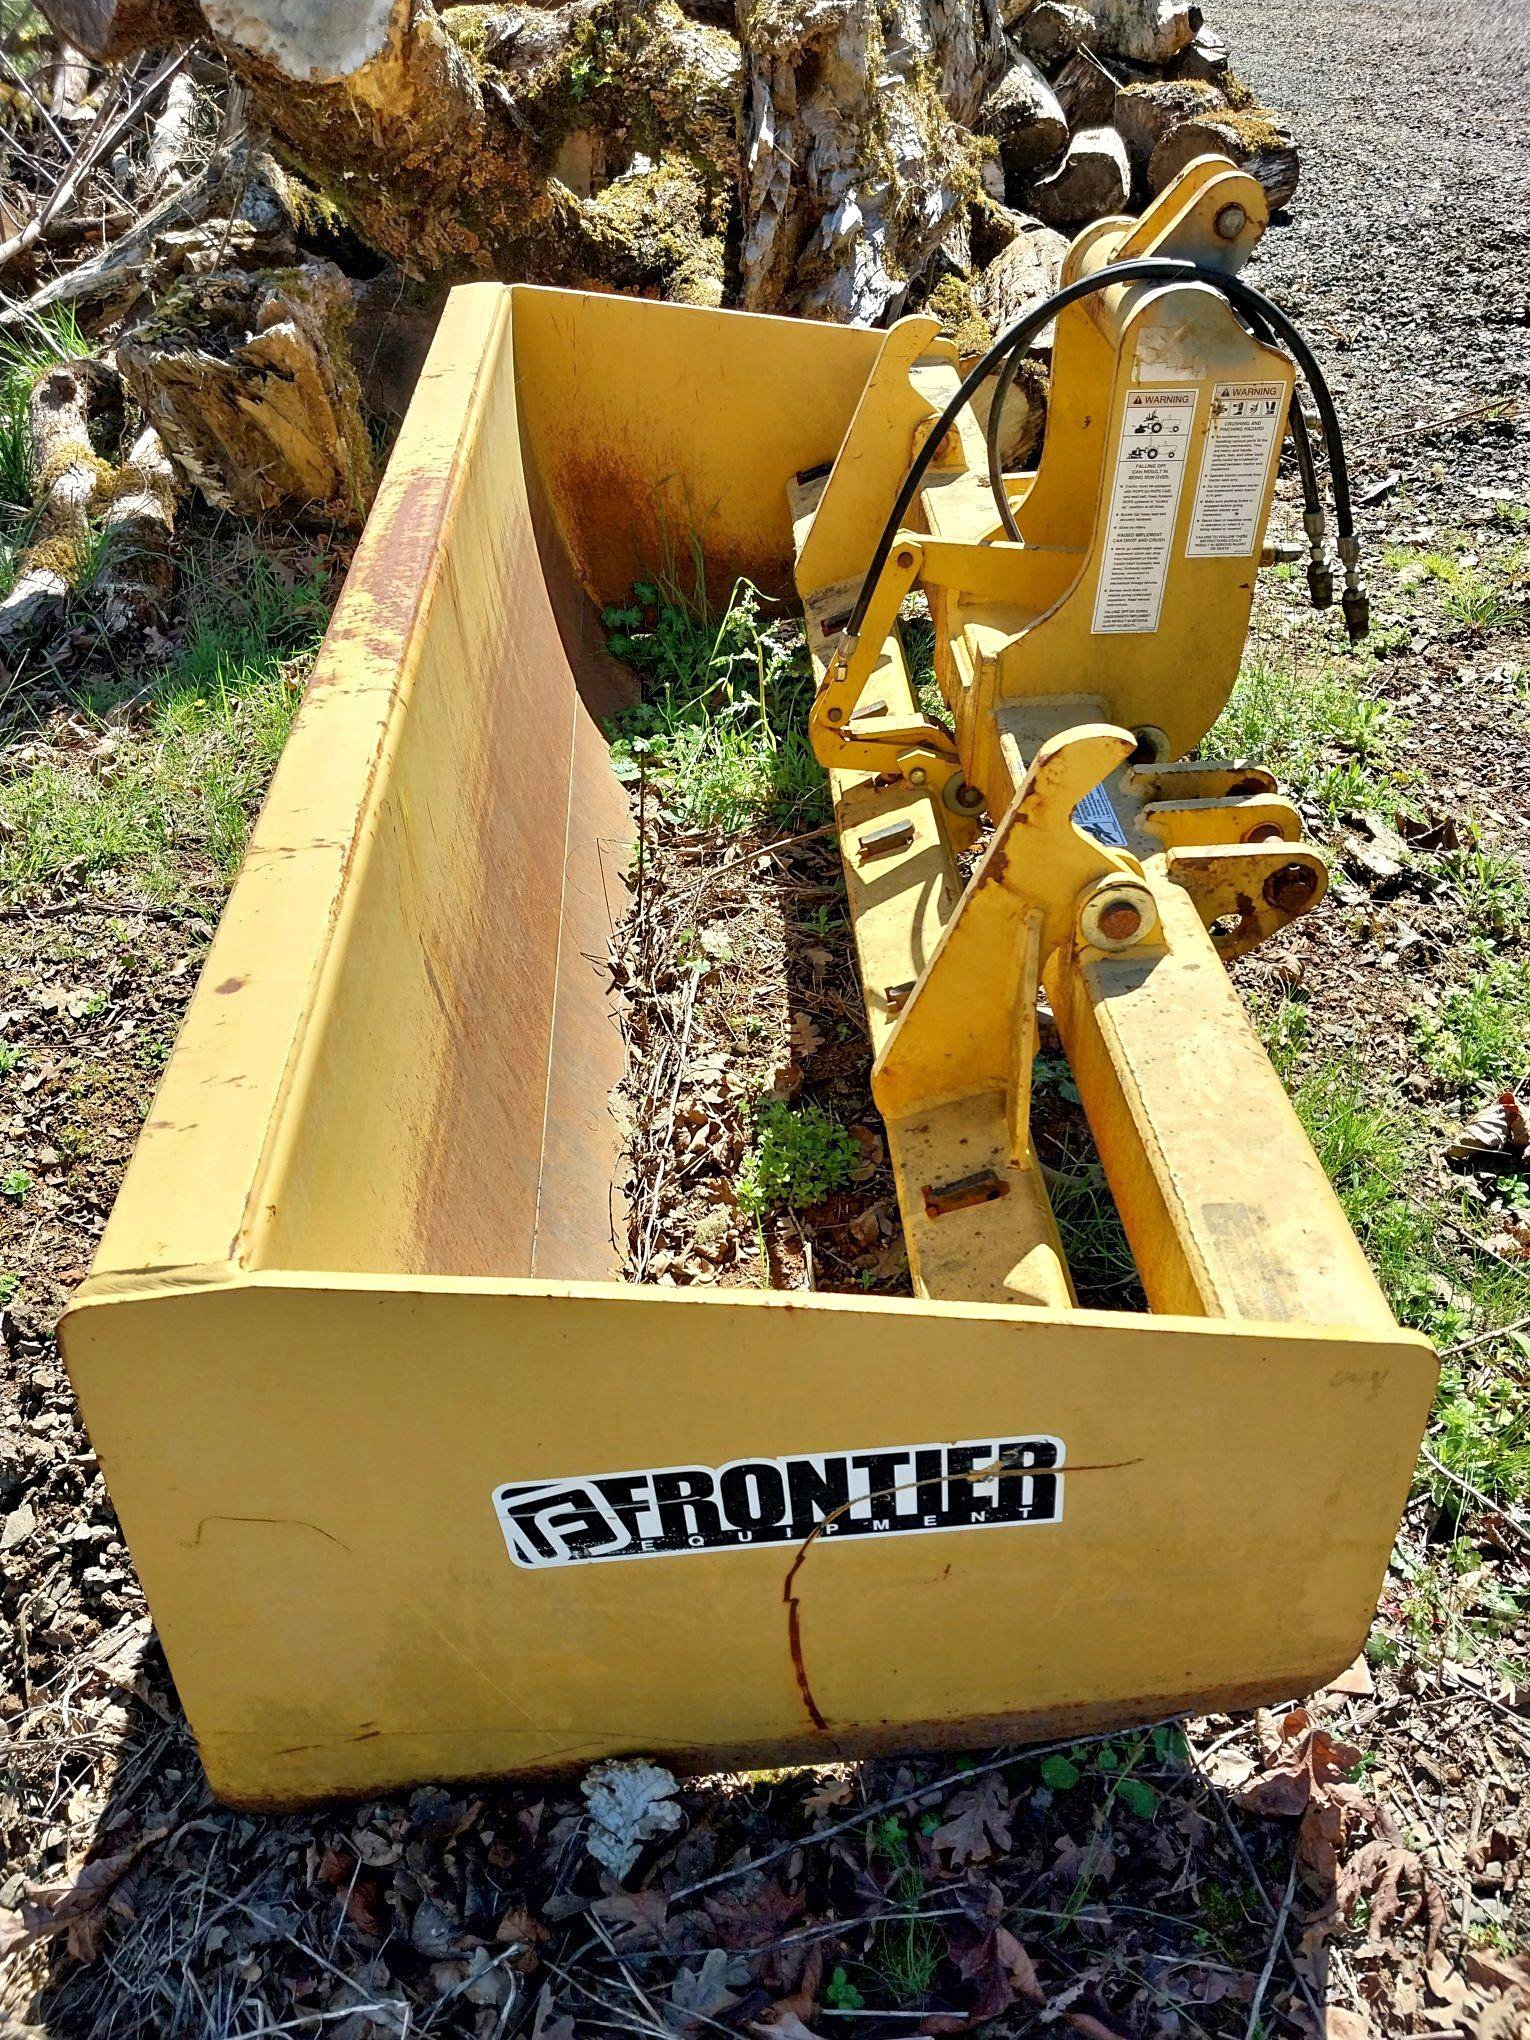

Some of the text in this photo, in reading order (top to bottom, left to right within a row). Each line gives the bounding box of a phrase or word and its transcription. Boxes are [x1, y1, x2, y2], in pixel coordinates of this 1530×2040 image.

[1145, 395, 1189, 404] WARNING
[1232, 387, 1277, 396] WARNING
[588, 1440, 1057, 1541] FRONTIER
[641, 1507, 1033, 1551] EQUIPMENT
